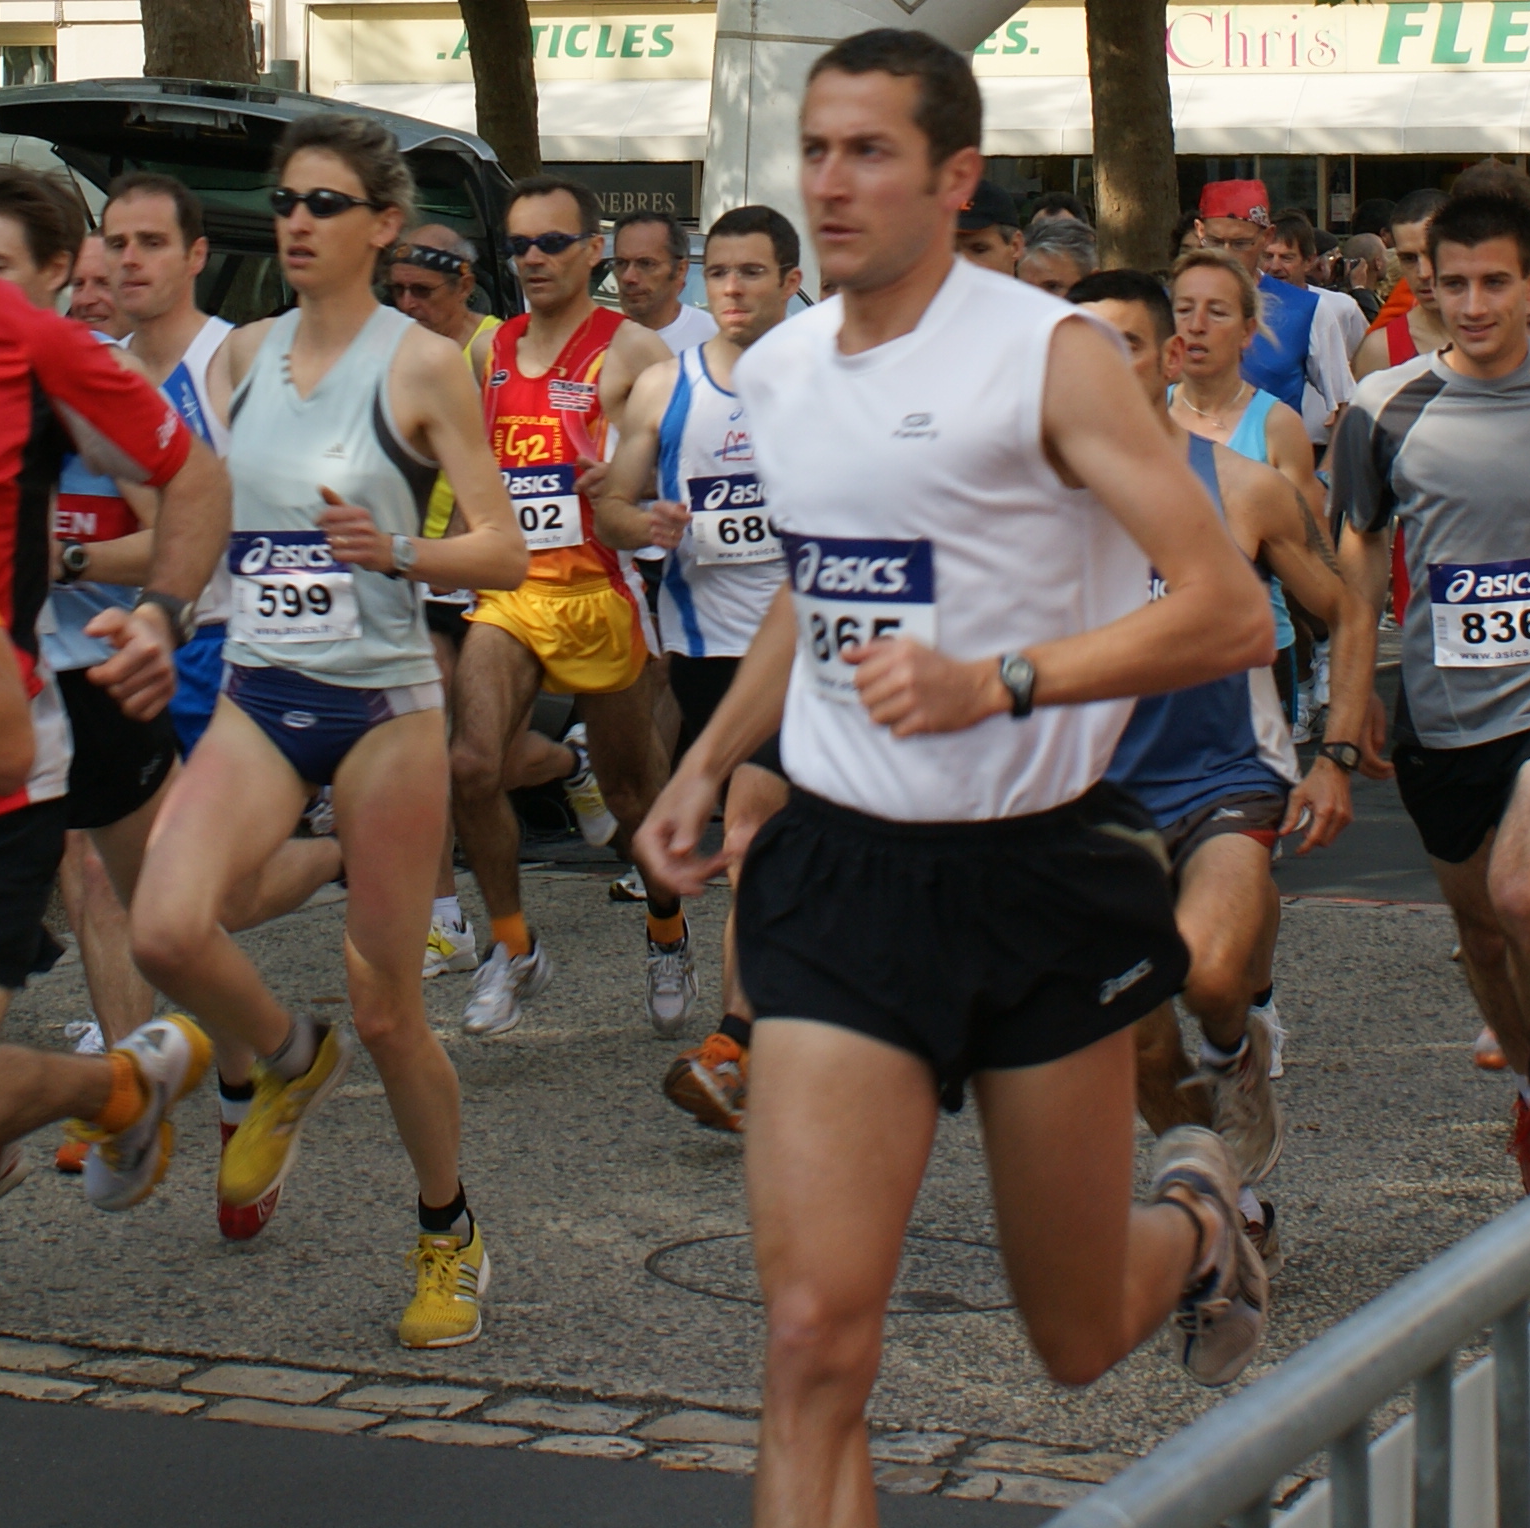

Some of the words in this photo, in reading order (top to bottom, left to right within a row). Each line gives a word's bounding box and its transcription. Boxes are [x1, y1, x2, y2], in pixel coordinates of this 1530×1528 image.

[1166, 11, 1337, 68] Chris
[509, 473, 562, 495] asics
[270, 543, 333, 568] asics
[818, 555, 908, 594] asics
[257, 583, 333, 618] 599
